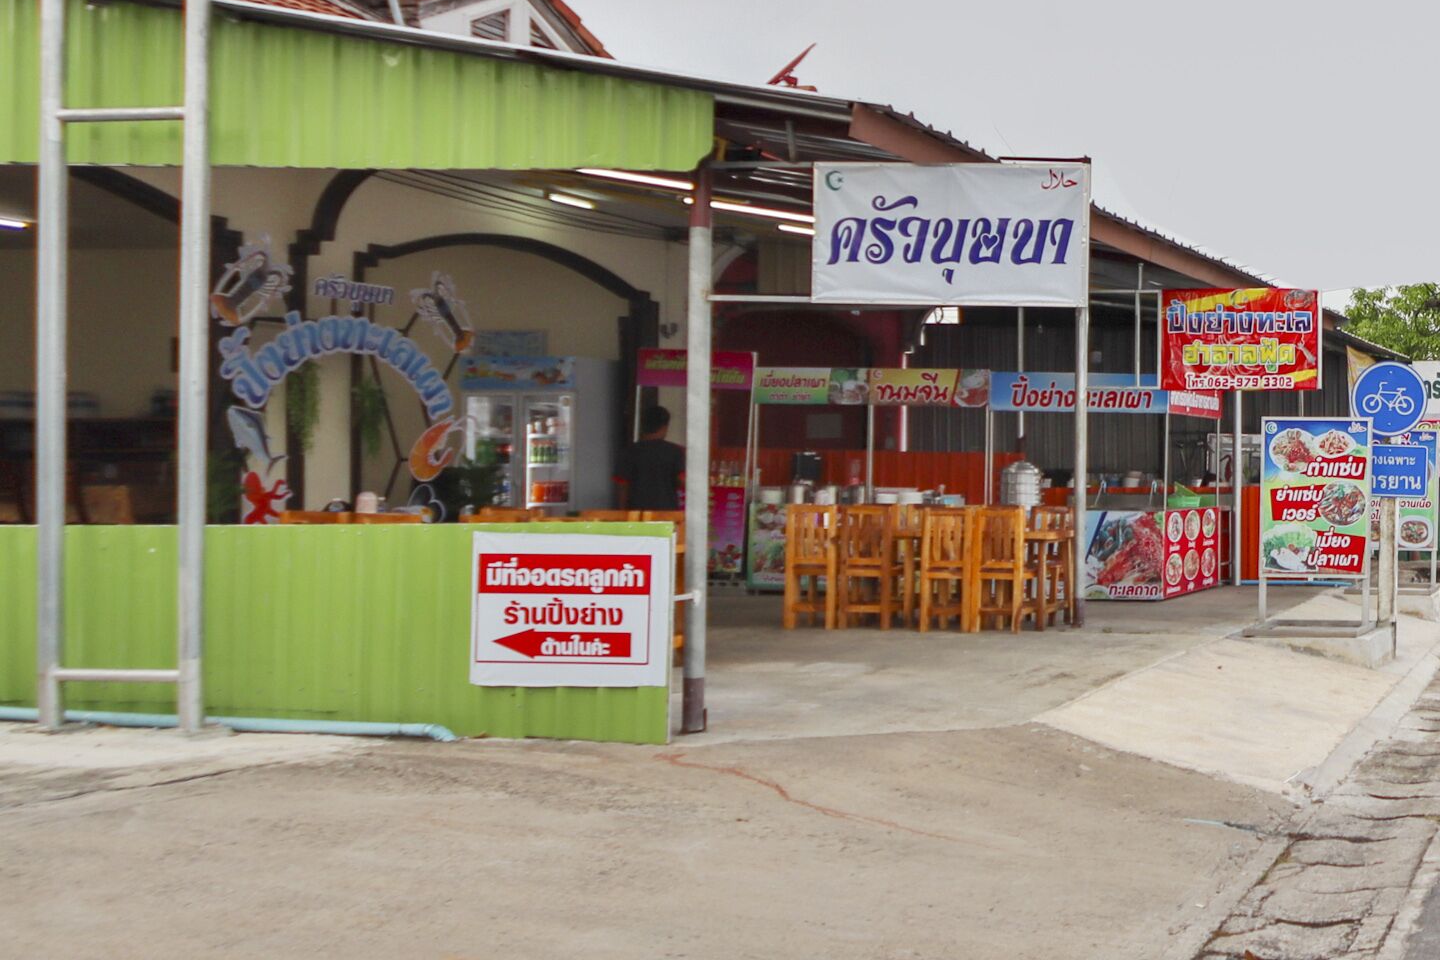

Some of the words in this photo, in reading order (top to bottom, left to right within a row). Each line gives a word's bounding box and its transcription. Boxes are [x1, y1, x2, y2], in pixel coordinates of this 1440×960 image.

[1041, 169, 1078, 190] حلال
[826, 195, 1075, 285] ครัวบุษบา
[1167, 300, 1313, 334] ปิ้งย่างทะเล
[1011, 376, 1153, 409] ปิ้งย่างะเลเผา
[1263, 376, 1293, 387] 3302
[1307, 457, 1364, 477] ตำแซ่บ
[1316, 526, 1350, 548] เมี่ยง
[485, 557, 645, 593] มีที่จอดรถลูกค้า
[504, 597, 623, 626] ร้านปิ้งย่าง
[541, 635, 611, 656] ด้านในค่ะ
